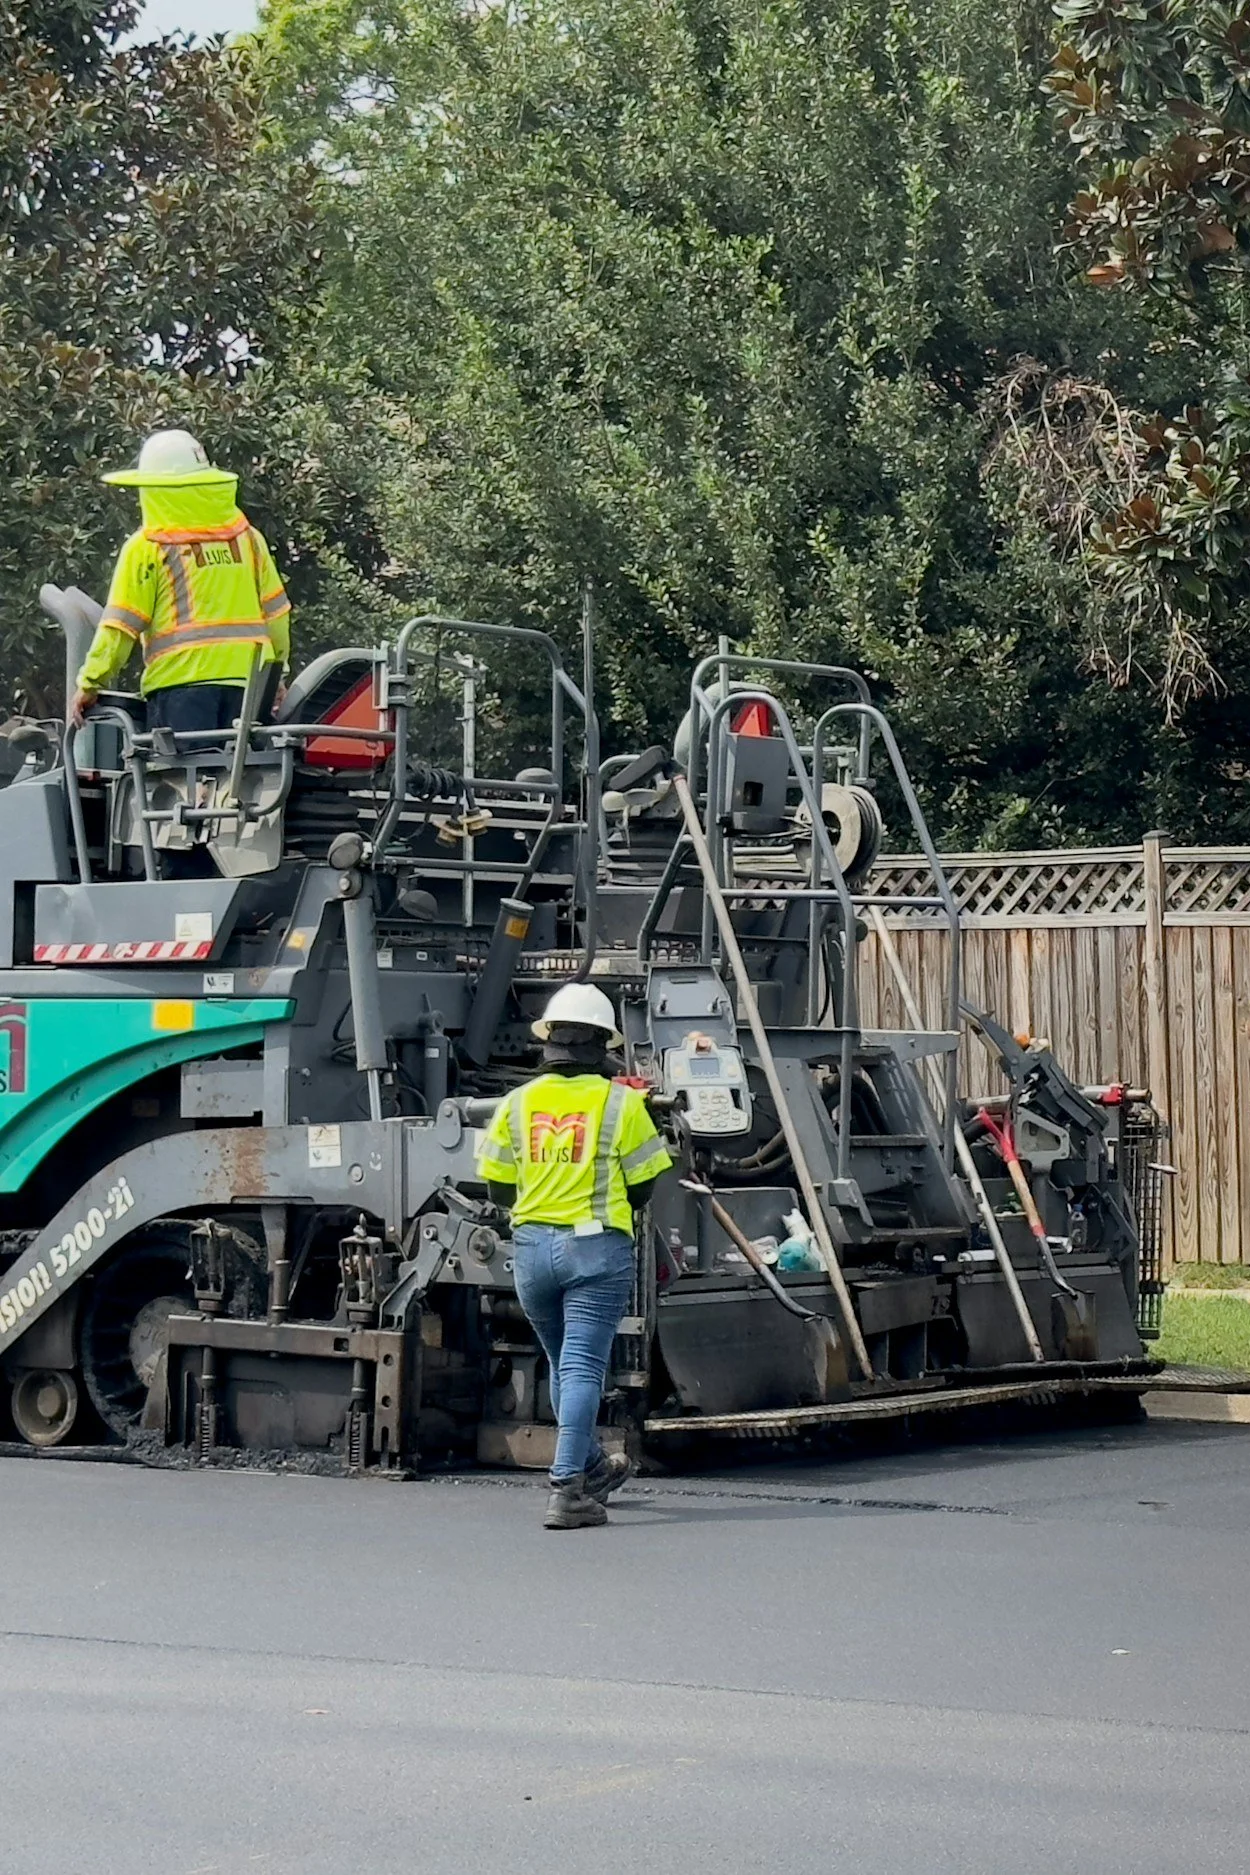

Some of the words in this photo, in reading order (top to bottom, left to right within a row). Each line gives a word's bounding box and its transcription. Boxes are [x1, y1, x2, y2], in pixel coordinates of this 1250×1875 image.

[206, 549, 232, 565] LUIS
[542, 1147, 569, 1162] LIS
[50, 1176, 135, 1277] 5200-2i
